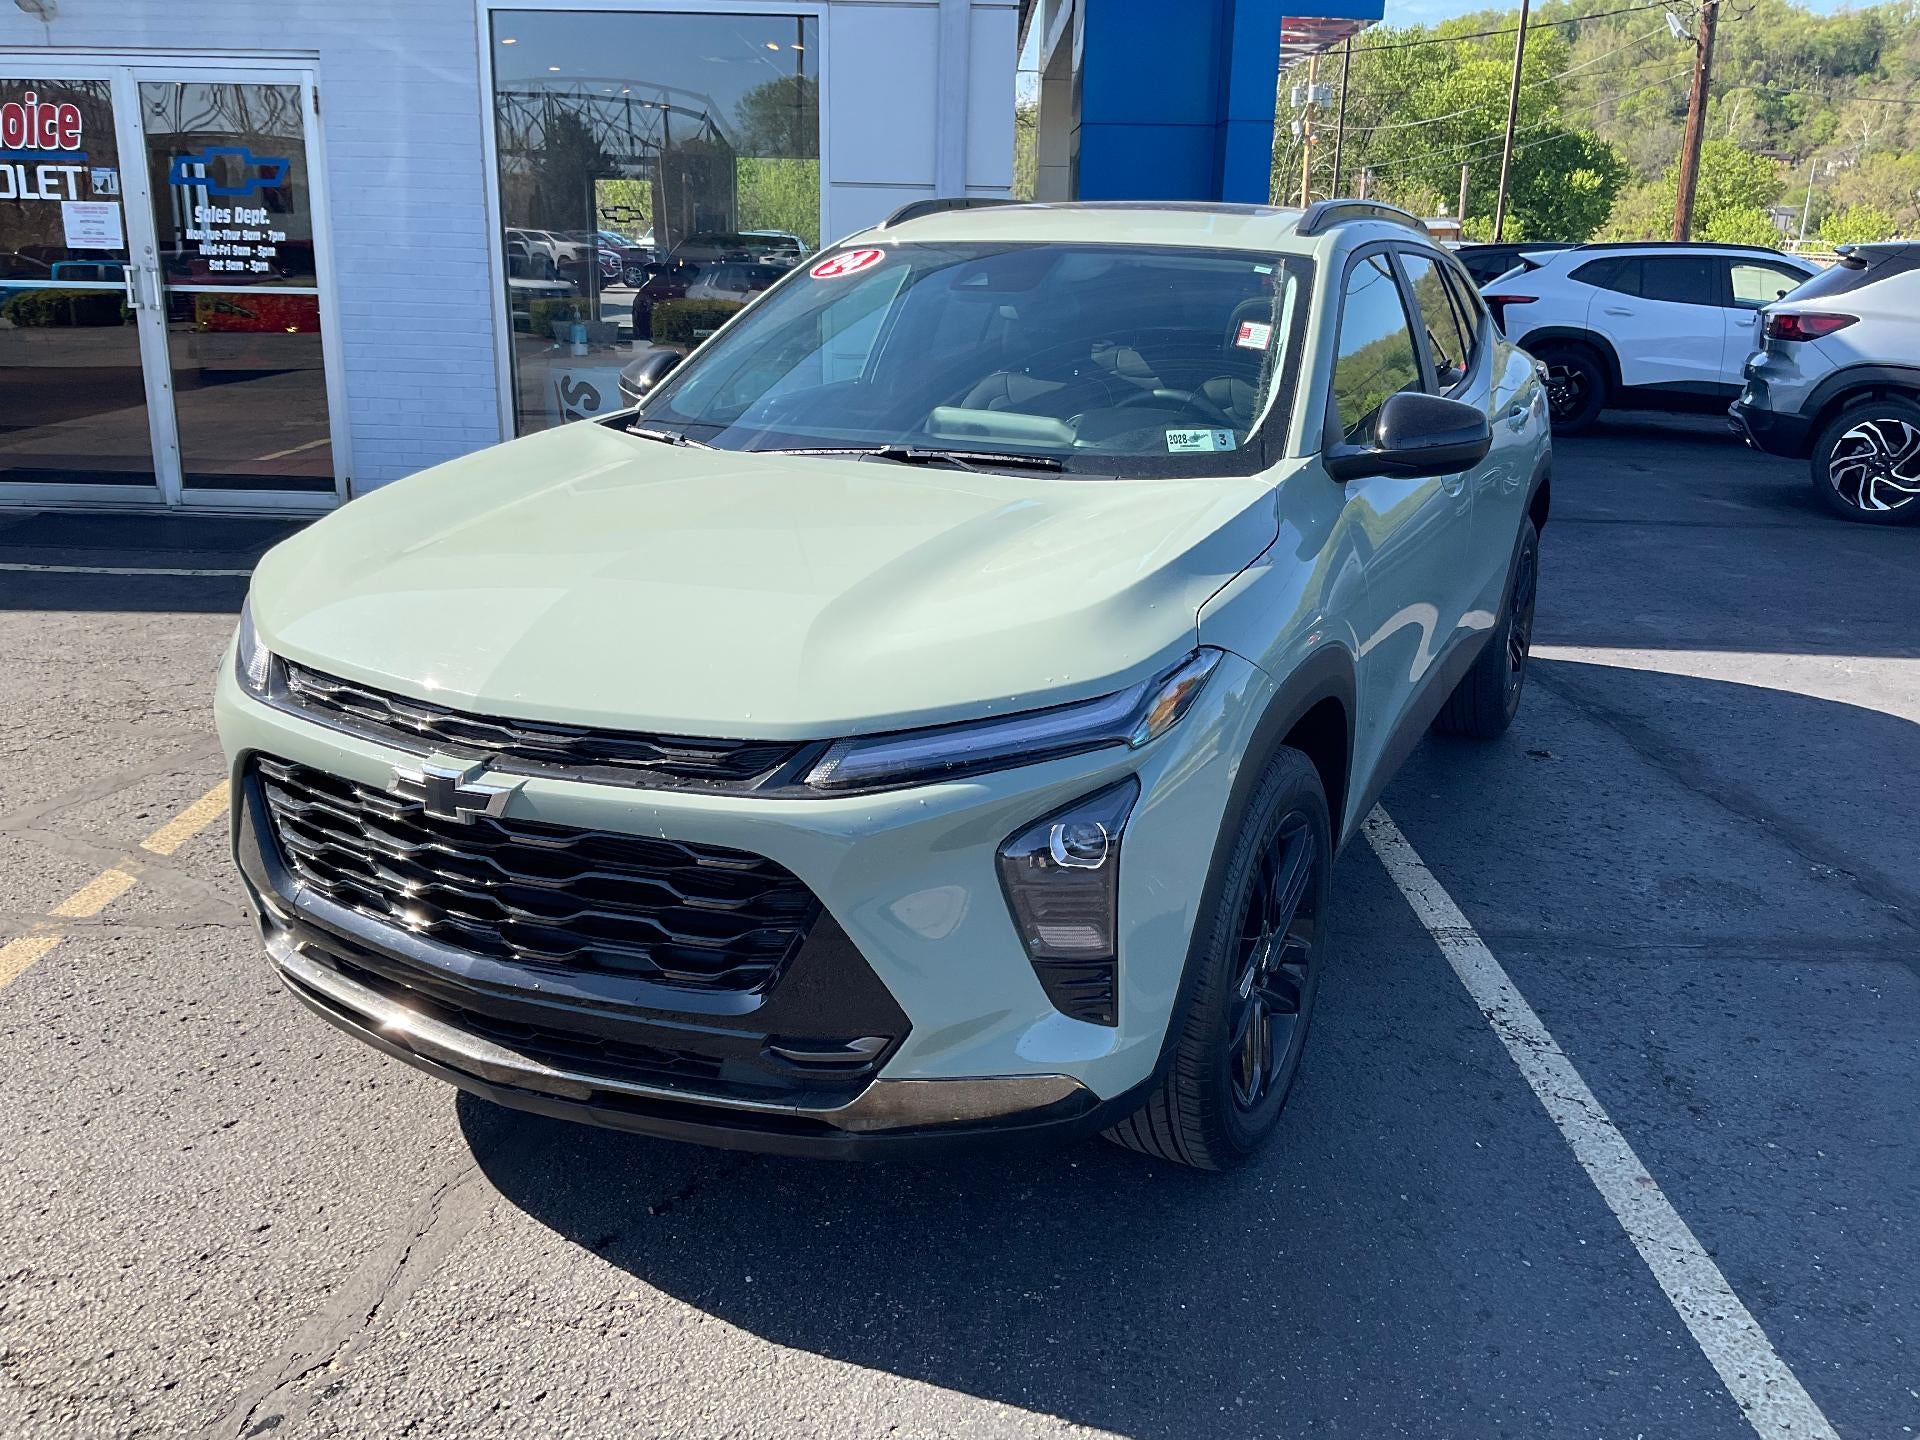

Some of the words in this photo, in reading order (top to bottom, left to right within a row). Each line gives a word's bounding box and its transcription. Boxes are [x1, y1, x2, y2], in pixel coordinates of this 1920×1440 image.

[0, 91, 82, 151] oice
[194, 205, 231, 223] Sales
[234, 206, 270, 226] Dept.
[242, 229, 261, 241] 9am
[267, 229, 286, 243] 7pm
[199, 243, 231, 256] Wed-Fri
[232, 244, 251, 256] 9am
[257, 245, 276, 258] 5pm
[208, 259, 224, 271] Sat
[225, 259, 244, 271] 9am
[250, 260, 269, 273] 3pm
[1168, 433, 1188, 445] 2028
[1218, 433, 1227, 446] 3
